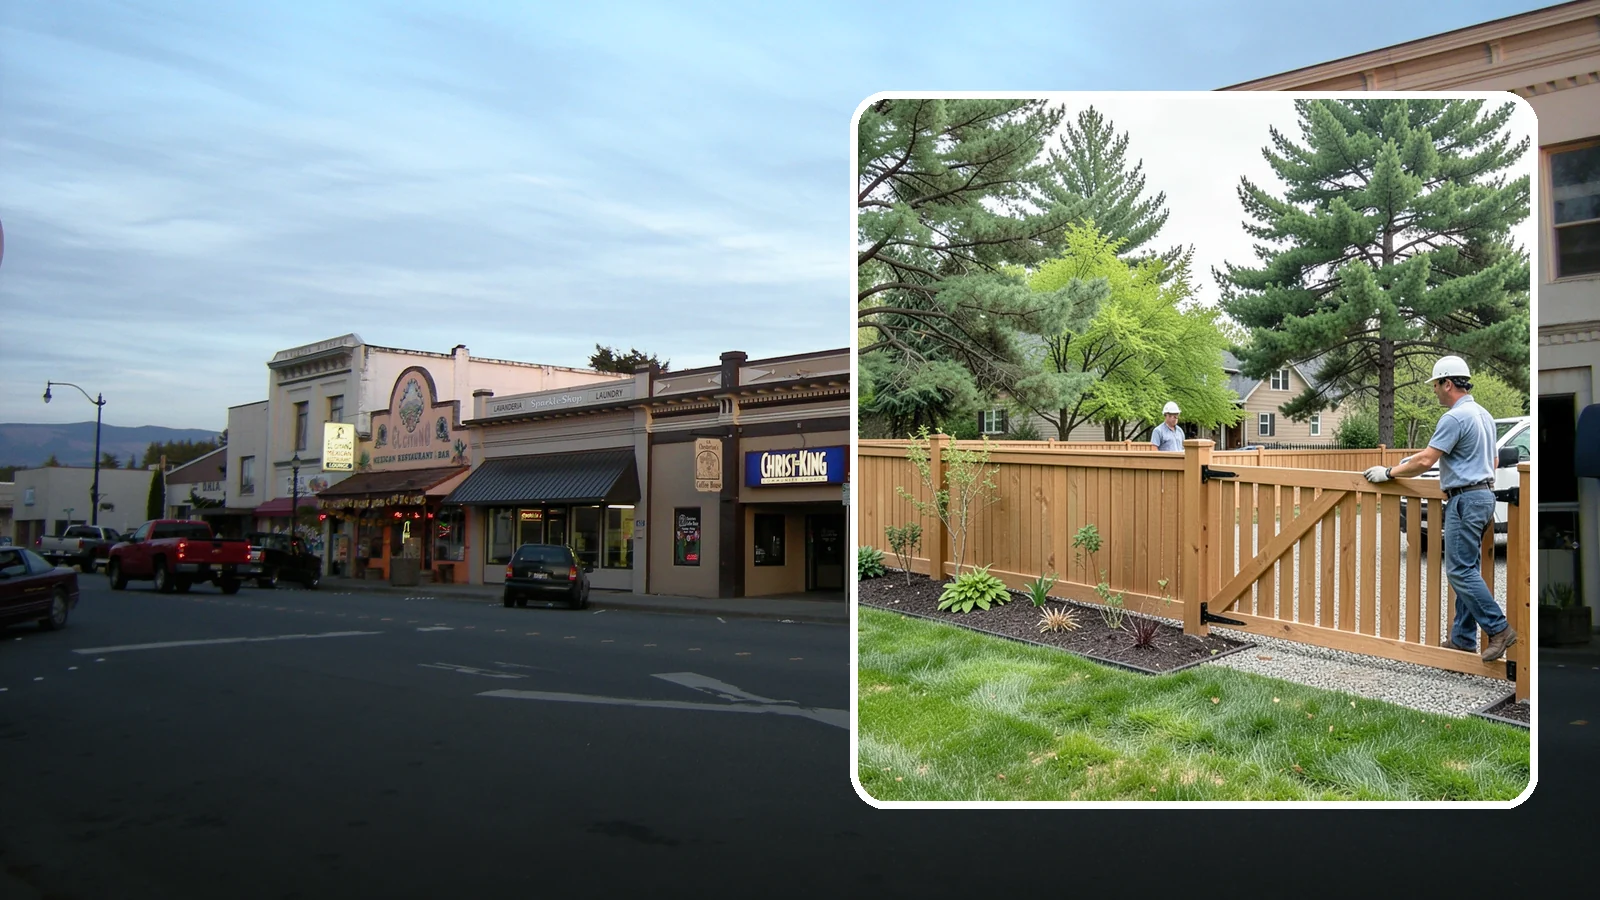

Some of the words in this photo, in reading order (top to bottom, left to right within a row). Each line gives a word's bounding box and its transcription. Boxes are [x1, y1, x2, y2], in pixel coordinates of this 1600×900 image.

[595, 389, 623, 400] LAUNDRY
[493, 402, 522, 412] LAVANDERIA
[398, 451, 434, 462] RESTAURANT
[438, 450, 450, 459] BAR
[761, 452, 797, 478] CHRIST
[799, 450, 827, 476] KING
[696, 480, 709, 488] Coffee
